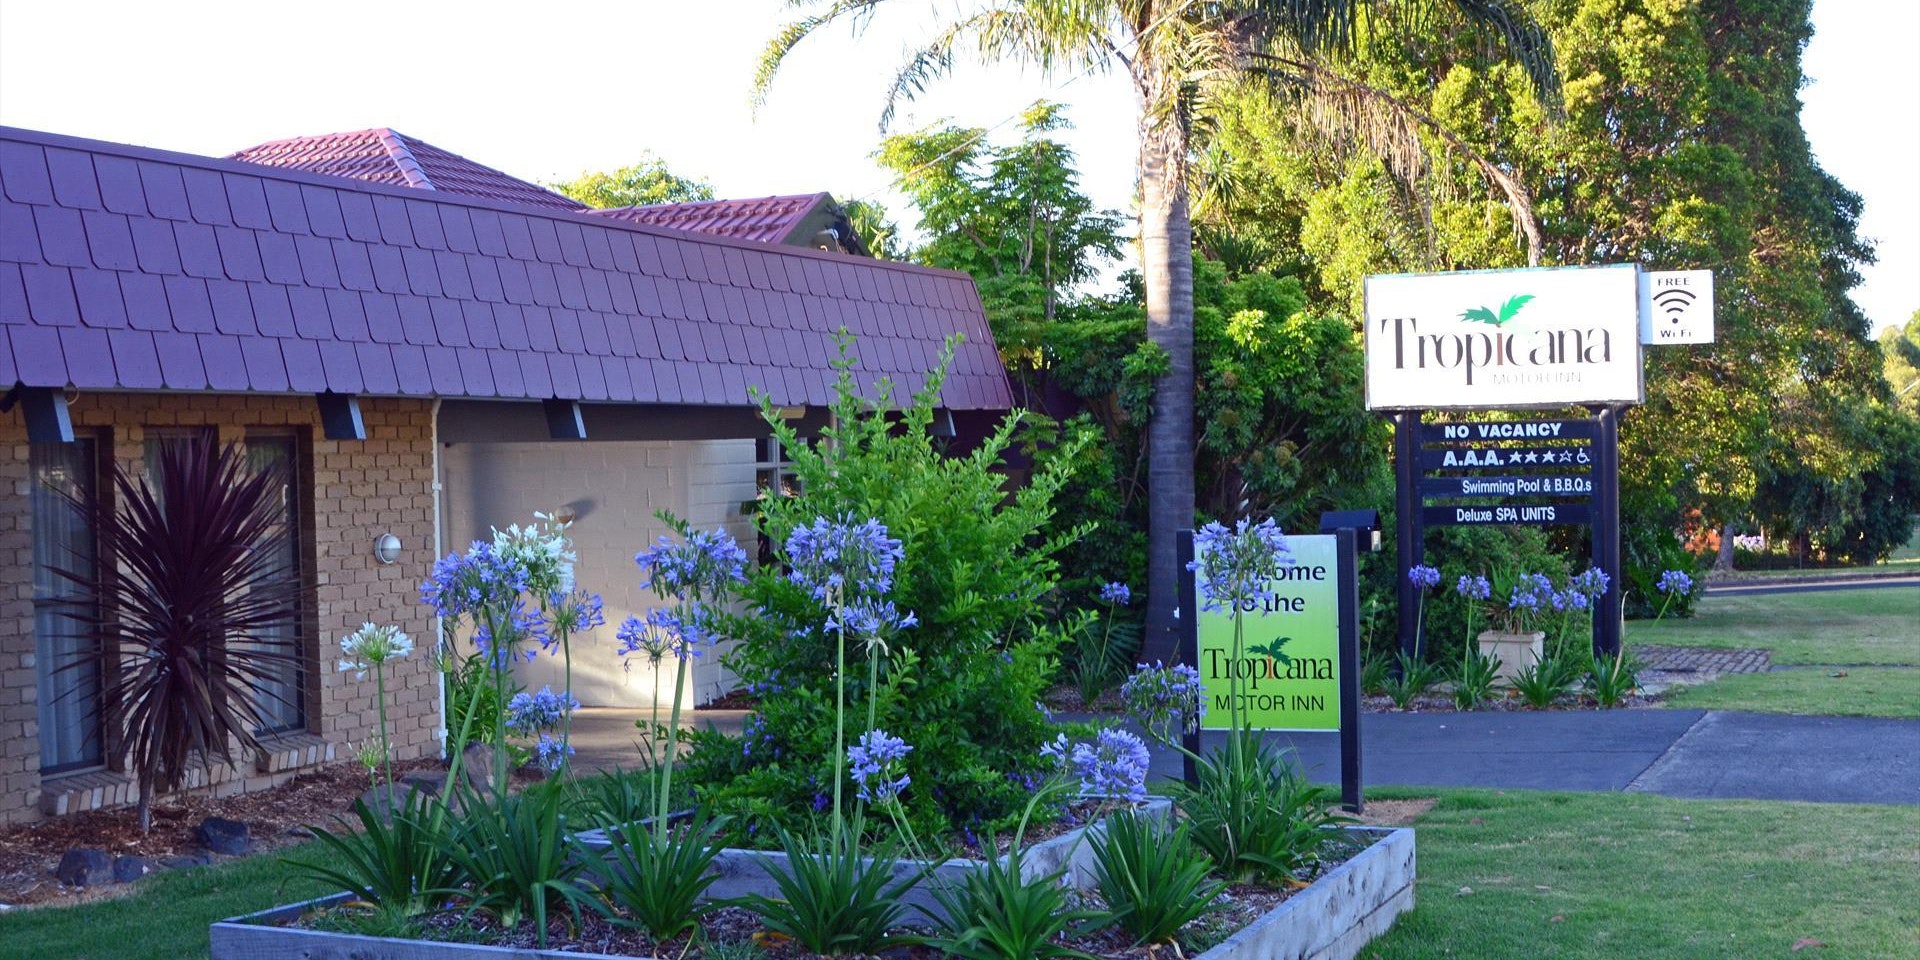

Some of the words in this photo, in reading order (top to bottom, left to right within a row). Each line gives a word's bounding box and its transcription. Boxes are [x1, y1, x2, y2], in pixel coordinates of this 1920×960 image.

[1657, 277, 1691, 286] FREE
[1381, 317, 1611, 386] Tropicana
[1444, 425, 1470, 438] NO
[1478, 422, 1562, 438] VACANCY
[1442, 450, 1505, 467] A.A.A.
[1462, 479, 1515, 496] Swimming
[1517, 478, 1540, 493] Pool
[1543, 479, 1551, 492] &
[1554, 477, 1592, 492] B.B.Q.s
[1456, 508, 1493, 522] Deluxe
[1496, 507, 1518, 521] SPA
[1521, 506, 1556, 521] UNITS
[1263, 593, 1305, 612] the
[1203, 648, 1335, 690] Tropicana
[1291, 695, 1325, 711] INN
